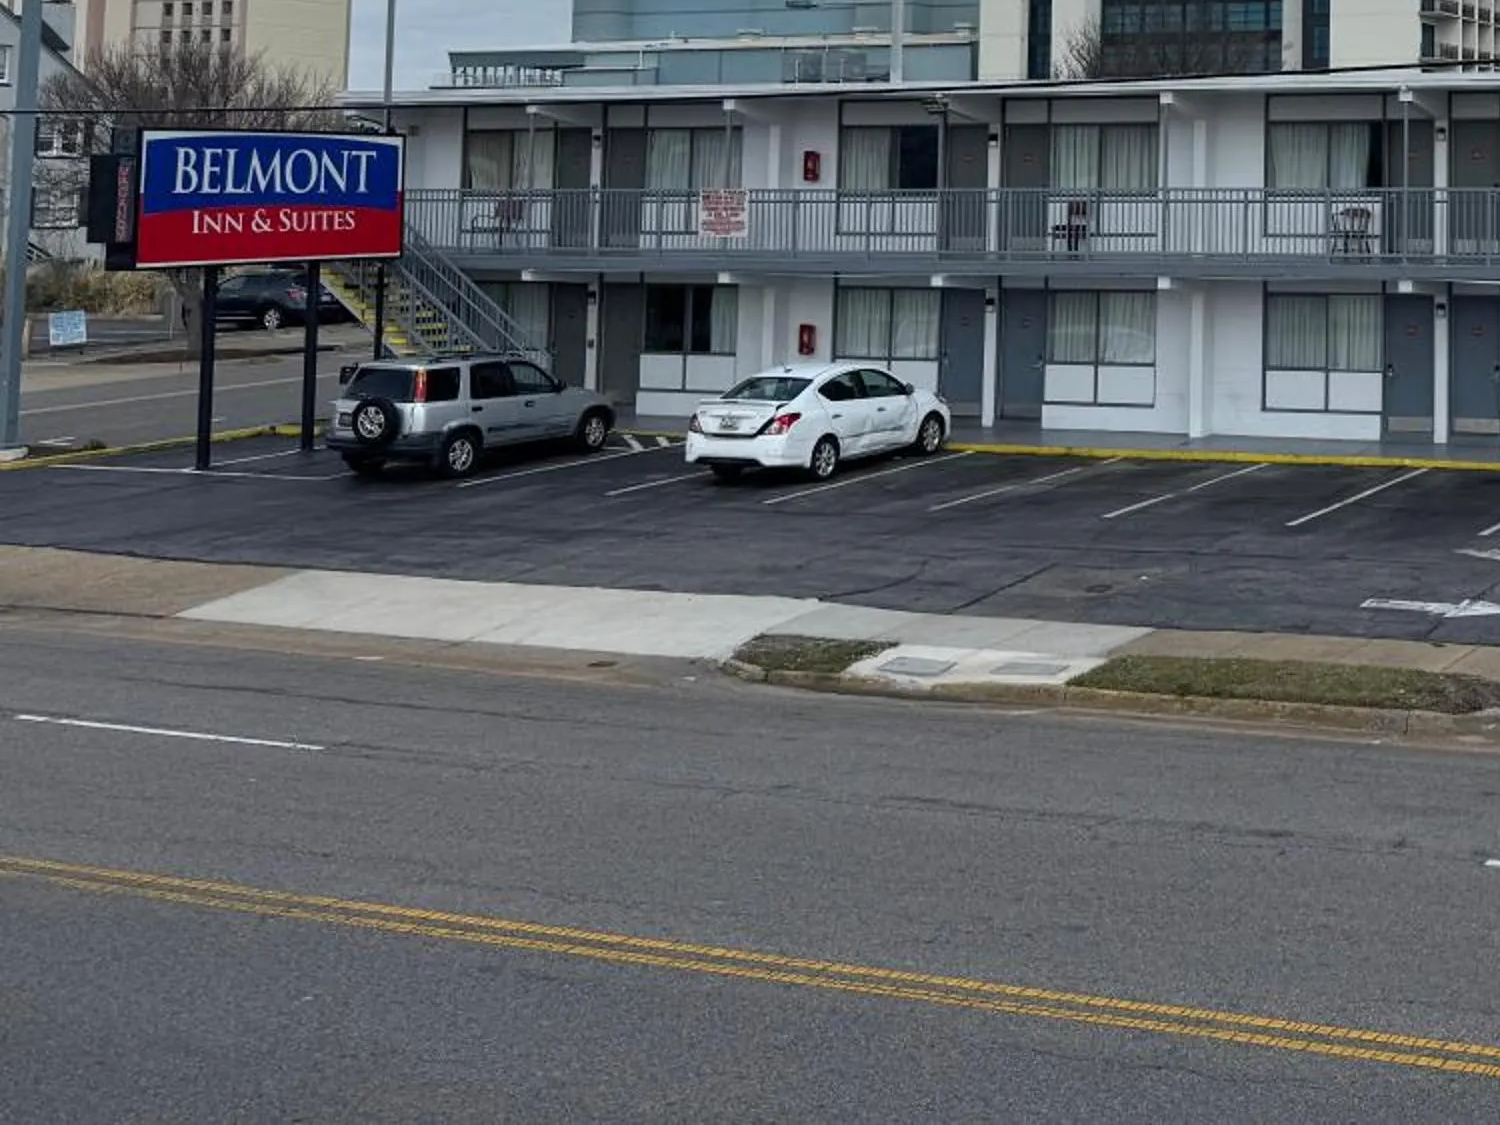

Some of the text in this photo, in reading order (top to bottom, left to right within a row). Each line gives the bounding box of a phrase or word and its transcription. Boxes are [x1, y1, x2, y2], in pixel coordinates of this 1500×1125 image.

[172, 146, 376, 194] BELMONT
[192, 209, 355, 234] INN & SUITES
